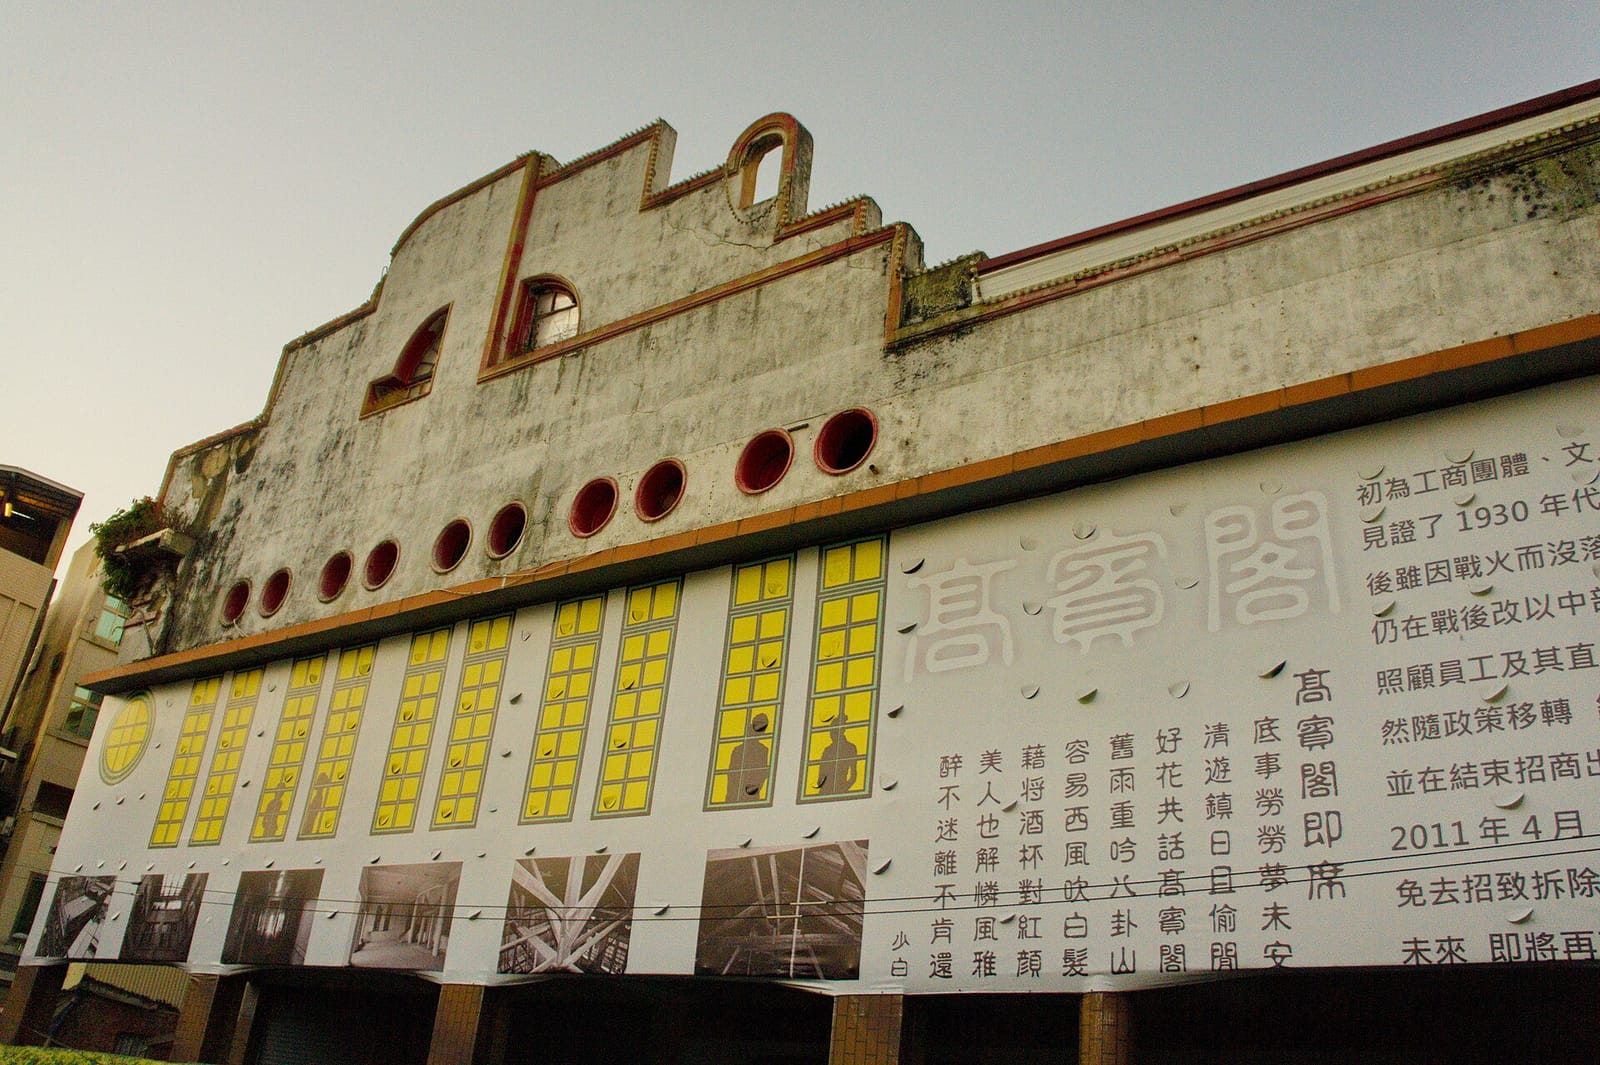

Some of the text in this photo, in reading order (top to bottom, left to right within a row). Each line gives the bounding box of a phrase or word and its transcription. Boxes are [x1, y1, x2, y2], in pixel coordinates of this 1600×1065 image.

[1363, 487, 1600, 551] 見證了 1930 年代
[1366, 534, 1600, 597] 後雖因戰火而沒落
[1376, 642, 1600, 696] 照顧員工及其直
[1381, 698, 1573, 746] 然隨政策移轉
[1062, 738, 1090, 977] 容易西風吹白髮
[1109, 732, 1138, 975] 舊雨重吟八卦山
[1390, 809, 1583, 851] 2011 年 4 月
[929, 753, 963, 979] 醉不迷離不肯還
[972, 748, 1003, 978] 美人也解憐風雅
[1396, 866, 1600, 908] 免去招致拆除
[890, 930, 911, 977] 少白
[1401, 935, 1468, 965] 未來
